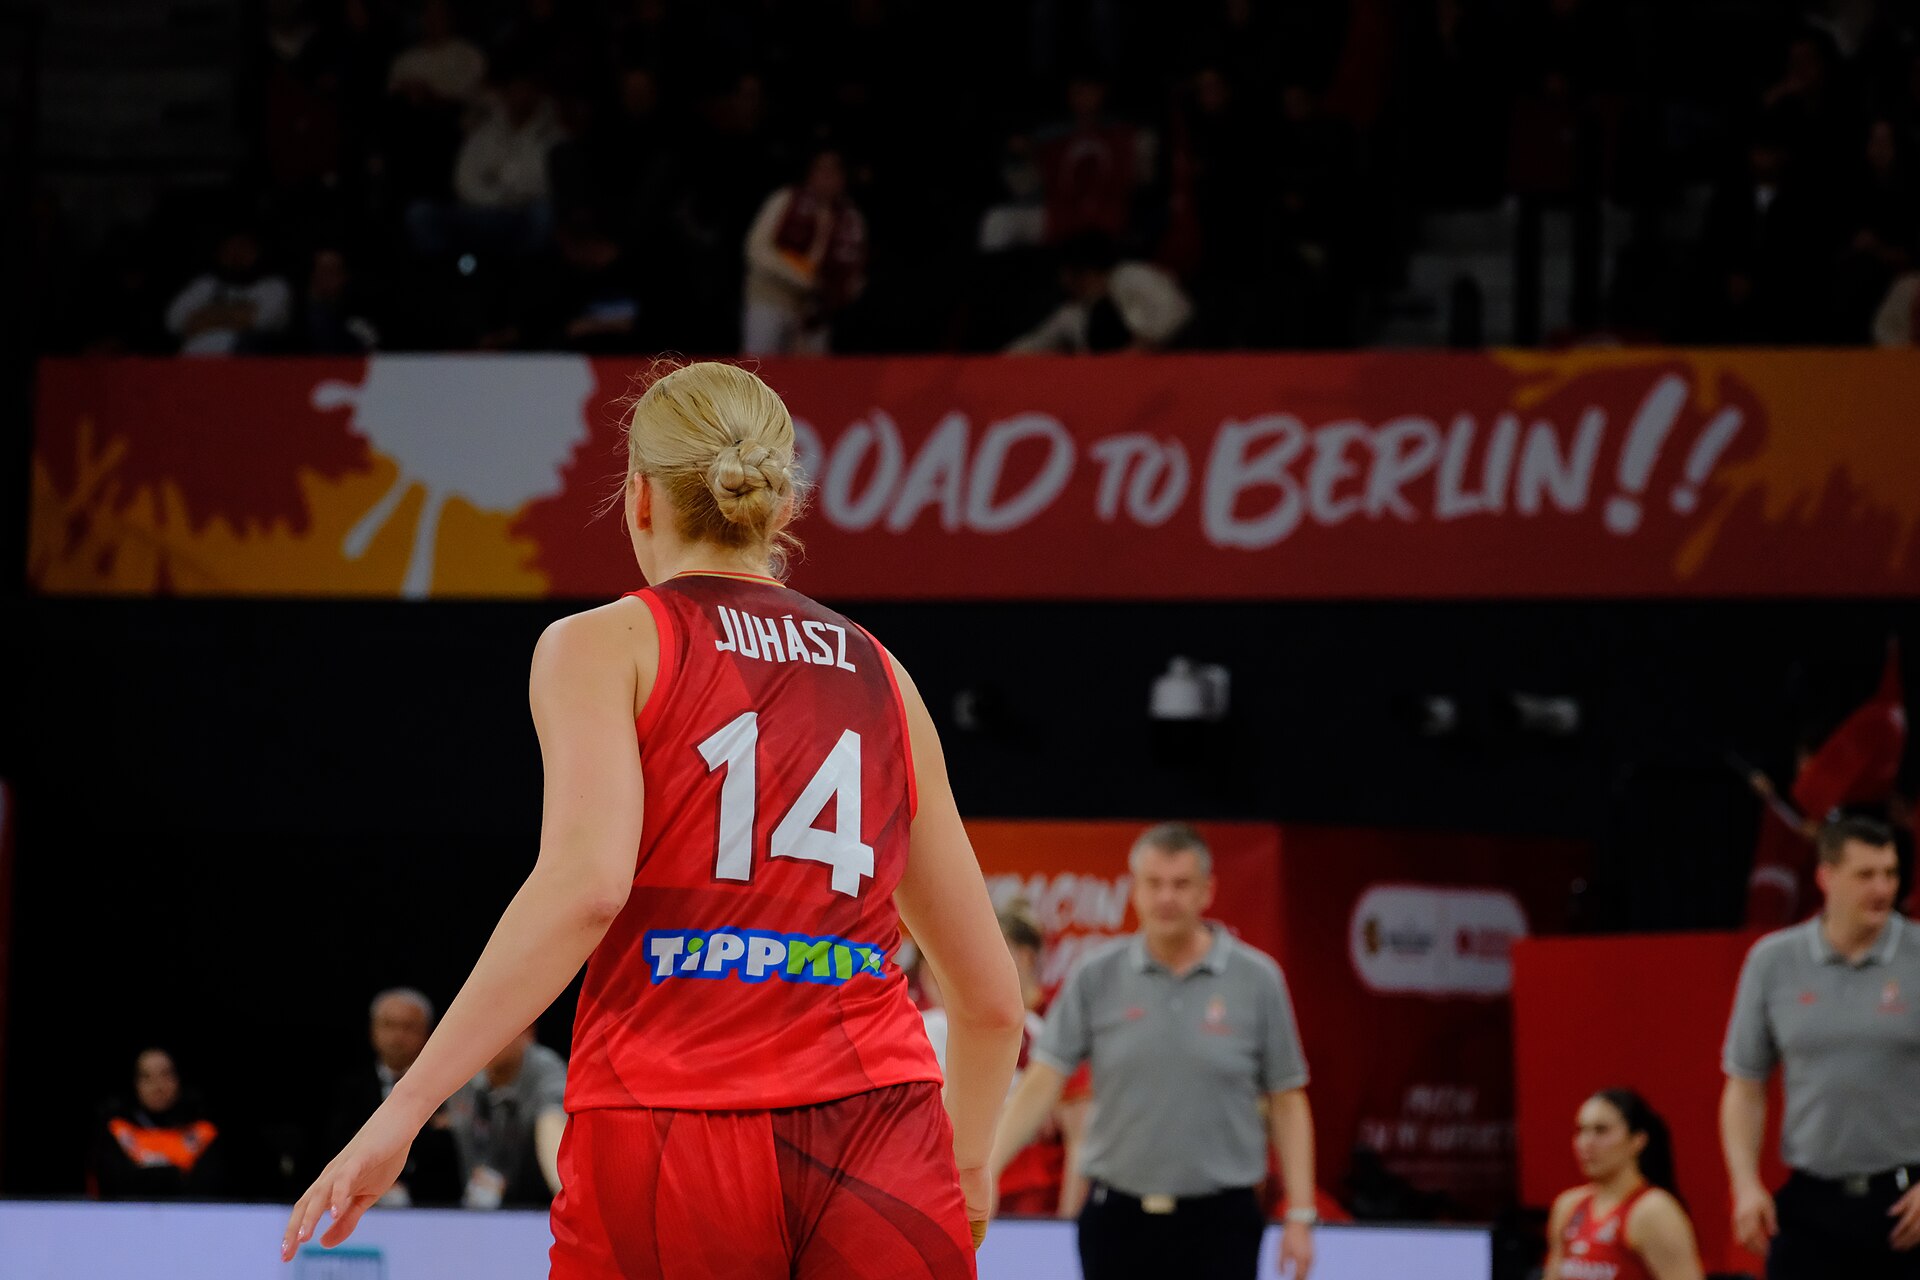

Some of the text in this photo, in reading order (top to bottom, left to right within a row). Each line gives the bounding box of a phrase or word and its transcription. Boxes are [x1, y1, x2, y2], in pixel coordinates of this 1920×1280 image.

[1091, 433, 1190, 526] TO
[1202, 375, 1743, 549] BERLIN!!
[715, 605, 857, 673] JUHÁSZ
[697, 711, 875, 898] 14
